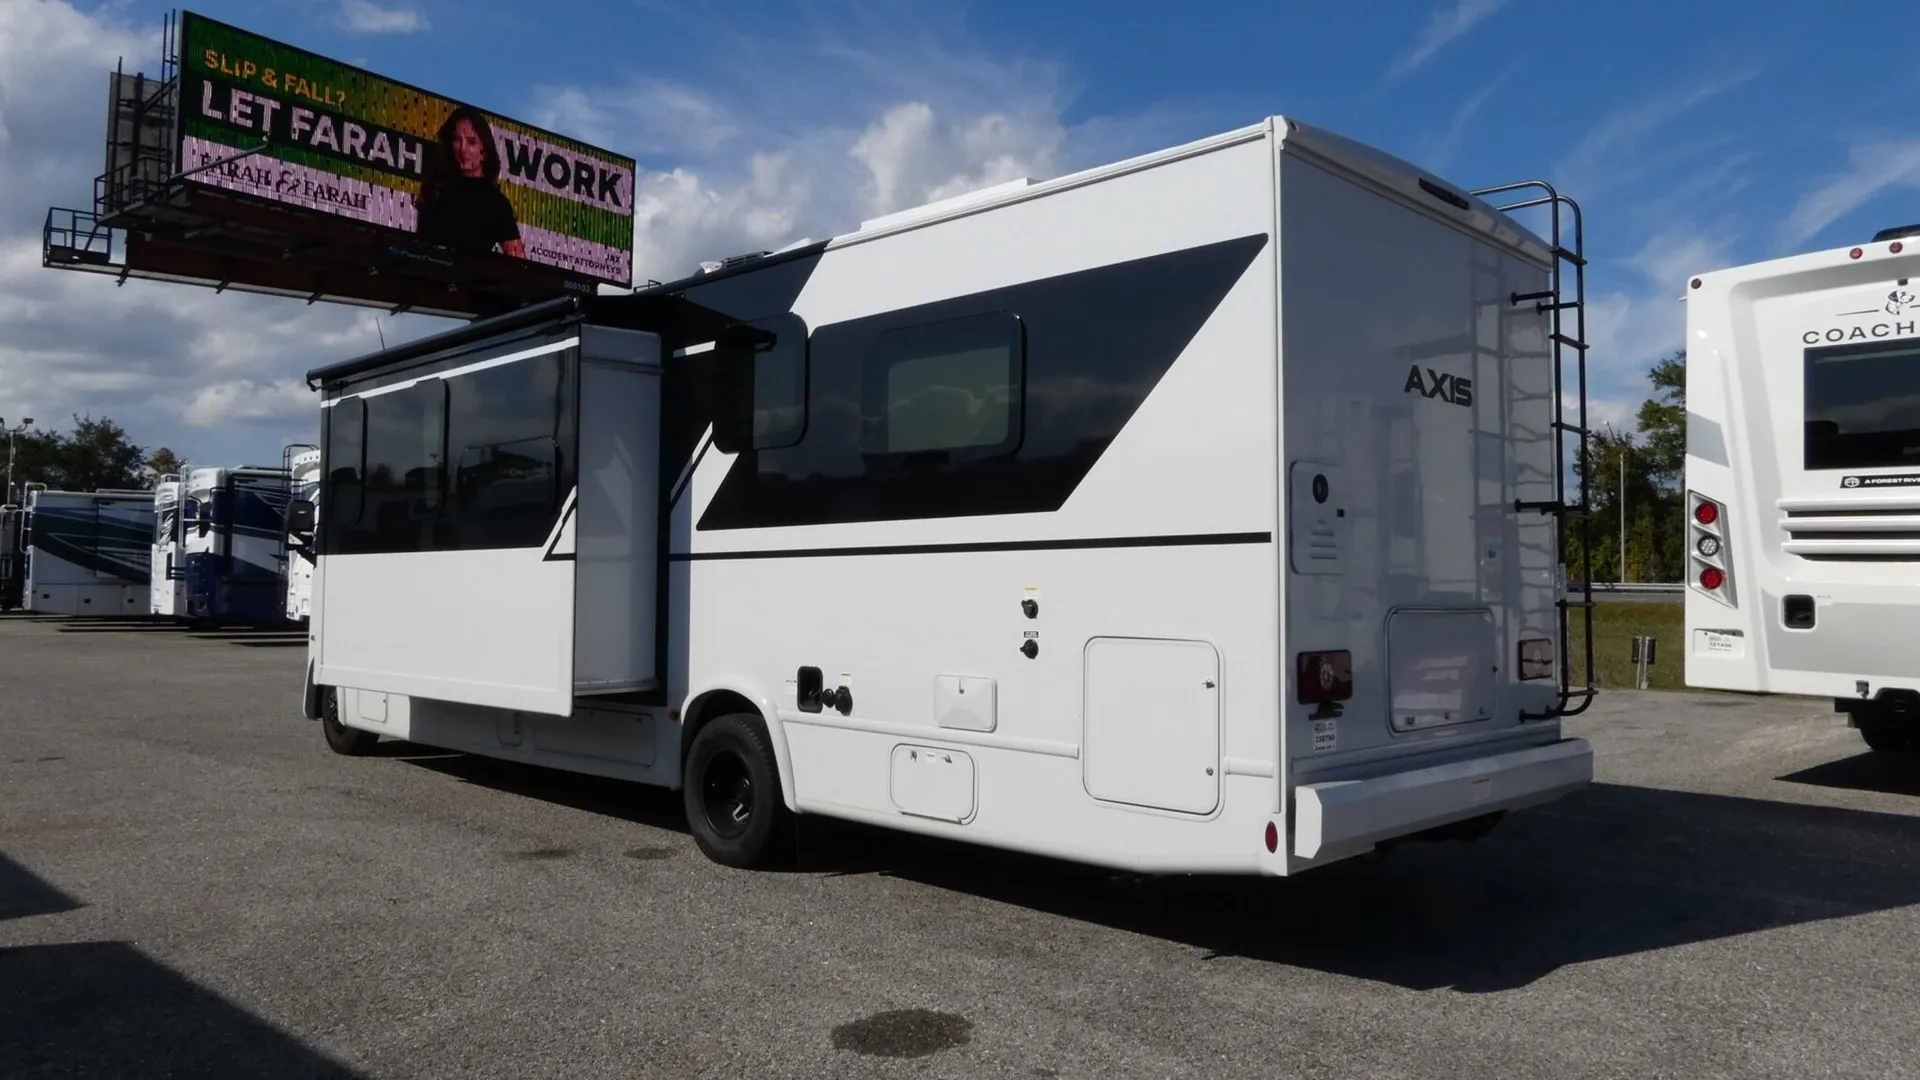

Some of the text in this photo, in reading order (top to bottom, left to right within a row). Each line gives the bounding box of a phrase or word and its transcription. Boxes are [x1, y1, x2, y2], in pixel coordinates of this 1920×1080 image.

[203, 48, 346, 107] SLIP & FALL?
[202, 80, 622, 207] LET FARAH WORK
[200, 152, 271, 186] FARAH
[303, 180, 368, 210] FARAH
[530, 245, 573, 263] ACCIDENT
[1404, 364, 1473, 407] AXIS
